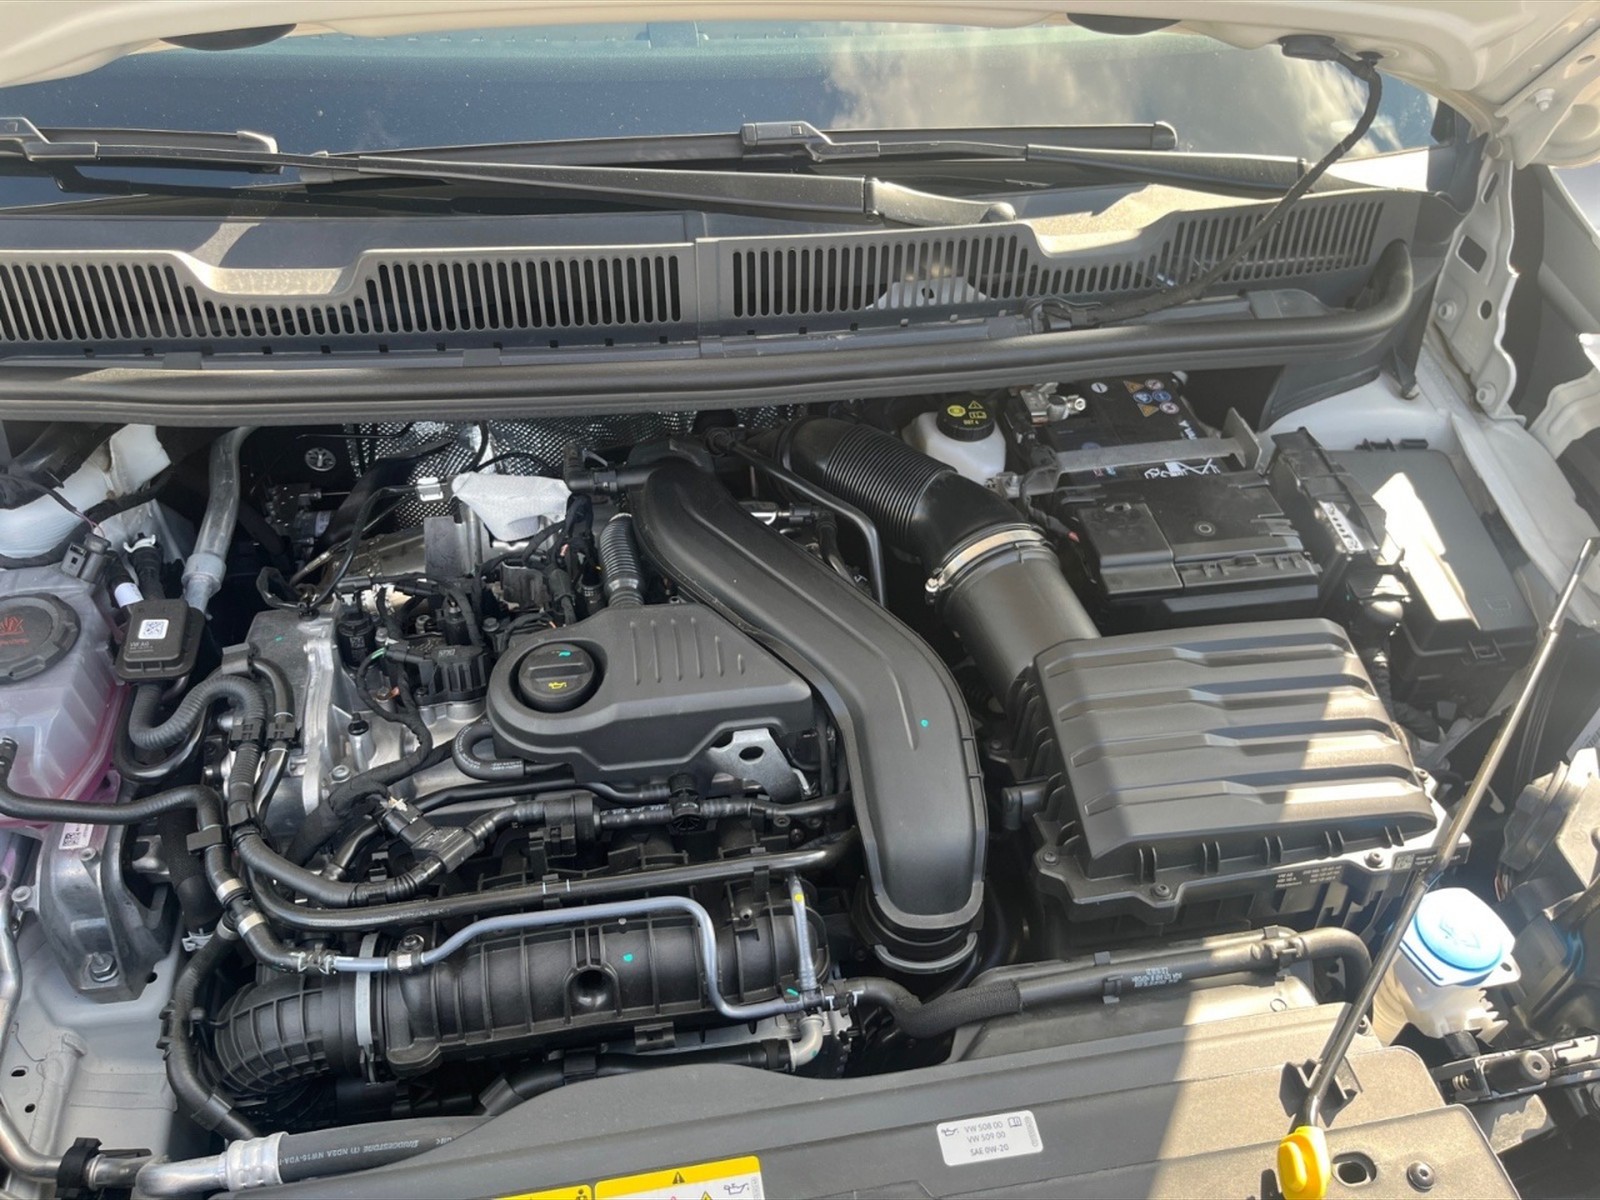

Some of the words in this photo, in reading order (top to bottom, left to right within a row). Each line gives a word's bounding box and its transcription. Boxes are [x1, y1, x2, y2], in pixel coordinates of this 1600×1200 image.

[964, 1124, 977, 1133] VW
[978, 1122, 992, 1131] 508
[993, 1120, 1003, 1129] 00
[966, 1134, 980, 1143] VW
[981, 1132, 995, 1141] 509
[996, 1131, 1006, 1139] 00
[970, 1146, 984, 1157] SAE
[984, 1143, 1009, 1154] 0W-20
